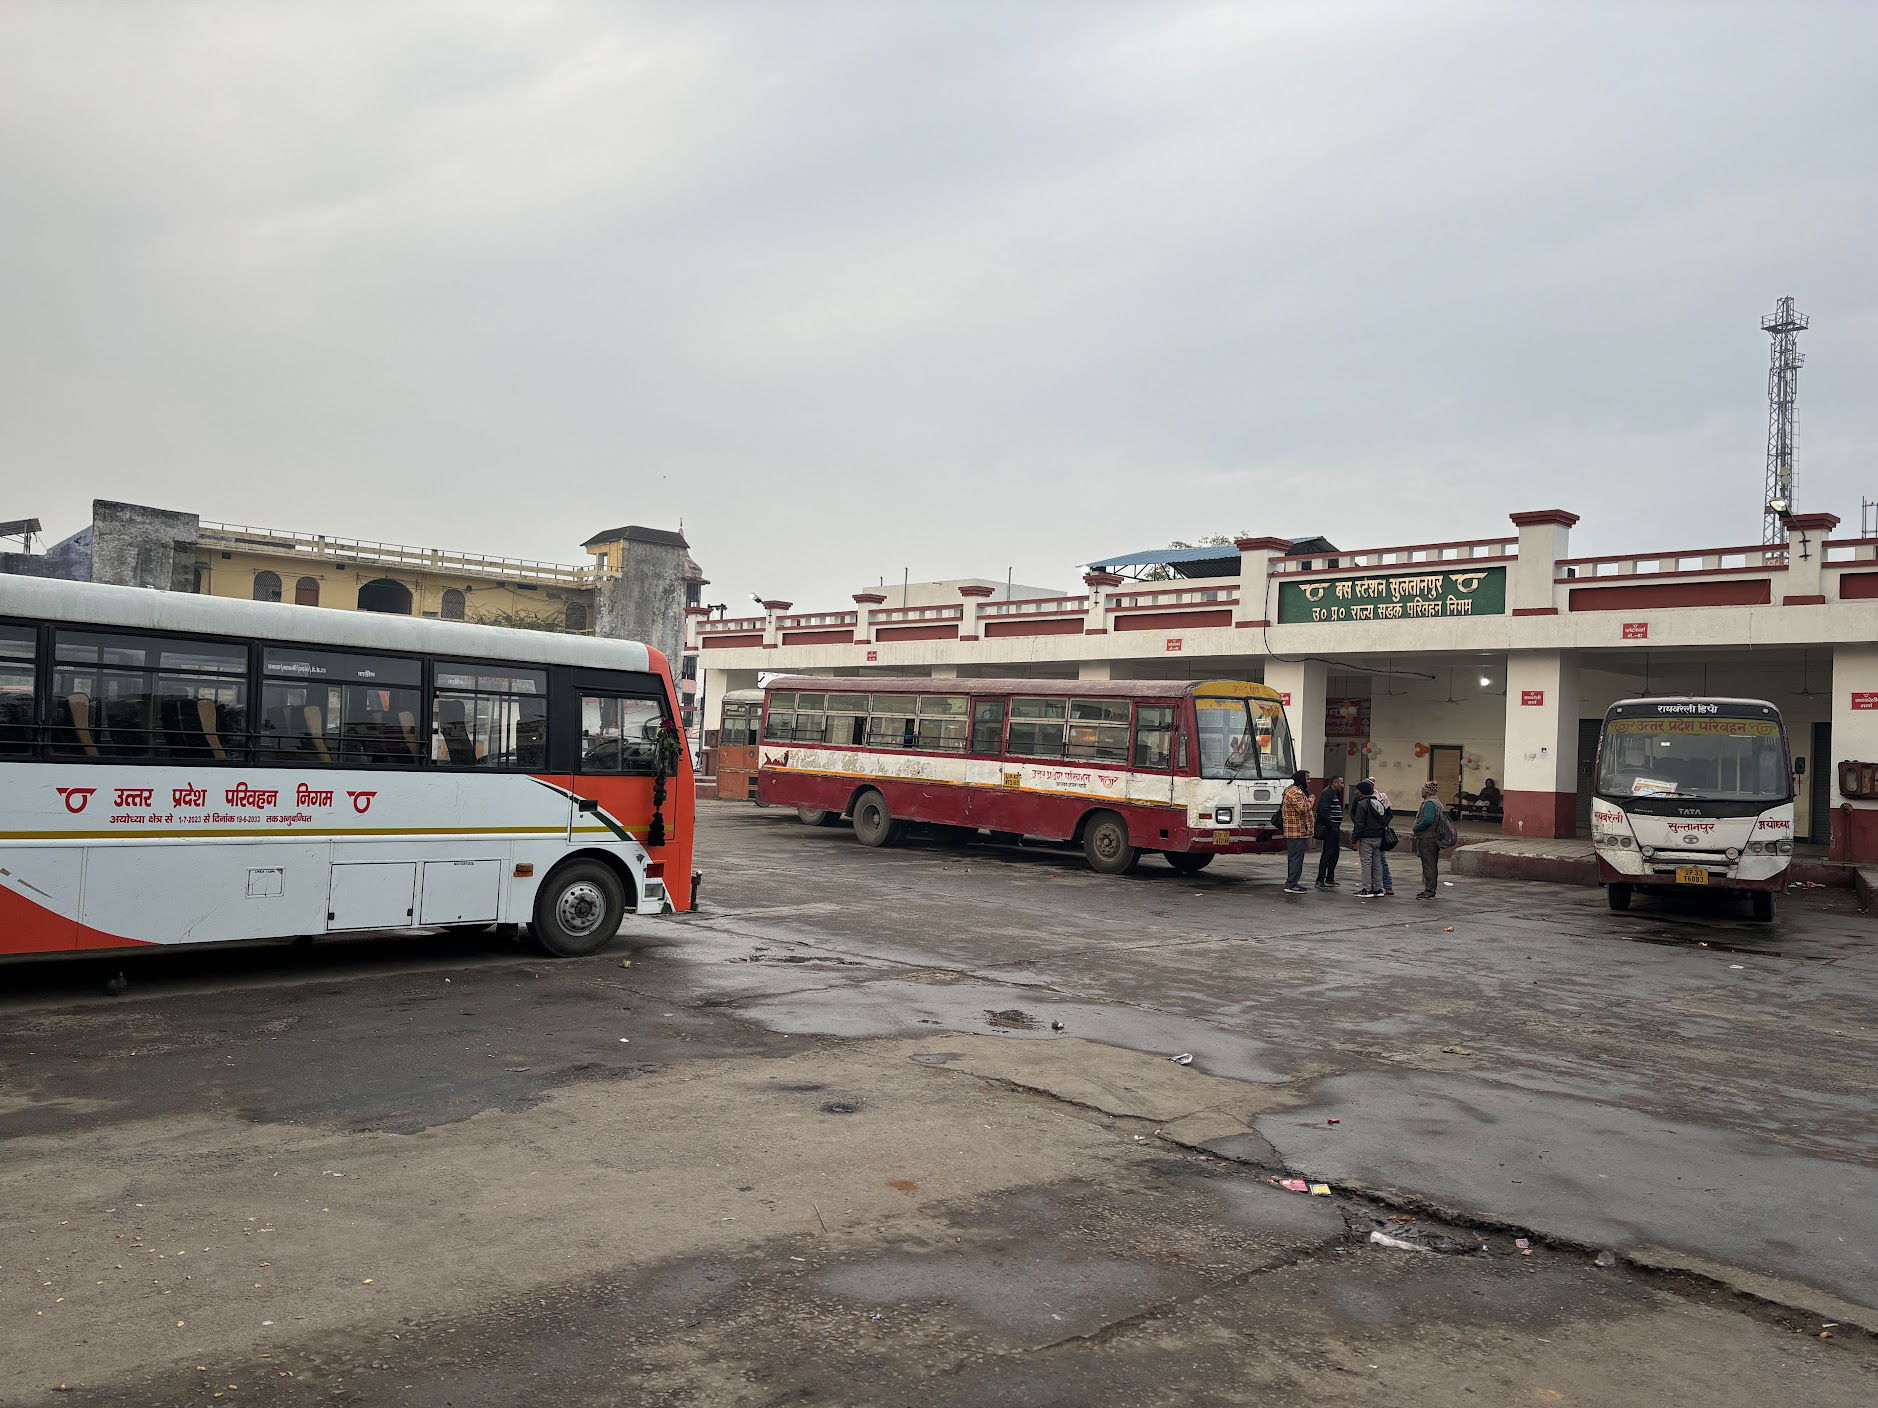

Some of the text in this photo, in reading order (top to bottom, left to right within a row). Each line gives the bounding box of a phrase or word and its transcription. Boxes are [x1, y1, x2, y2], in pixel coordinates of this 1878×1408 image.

[1336, 575, 1444, 602] बस स्टेशन सुलतानपुर
[1351, 604, 1375, 620] राज्य
[1377, 603, 1403, 621] सड़क
[1407, 596, 1443, 619] परिवहन
[1446, 594, 1473, 616] निगम
[1657, 703, 1719, 715] रायबरेली डिपो
[1636, 718, 1746, 735] उत्तर प्रदेश परिवहन
[113, 781, 334, 810] उत्तर प्रदेश परिवहन निगम
[109, 812, 145, 824] अयोध्या
[148, 812, 163, 824] क्षेत्र
[165, 812, 174, 824] से
[203, 812, 211, 823] से
[212, 812, 236, 823] दिनांक
[266, 814, 278, 823] तक
[1677, 808, 1703, 816] TATA
[1667, 822, 1716, 835] सुल्तानपुर
[1757, 816, 1791, 831] अयोध्या
